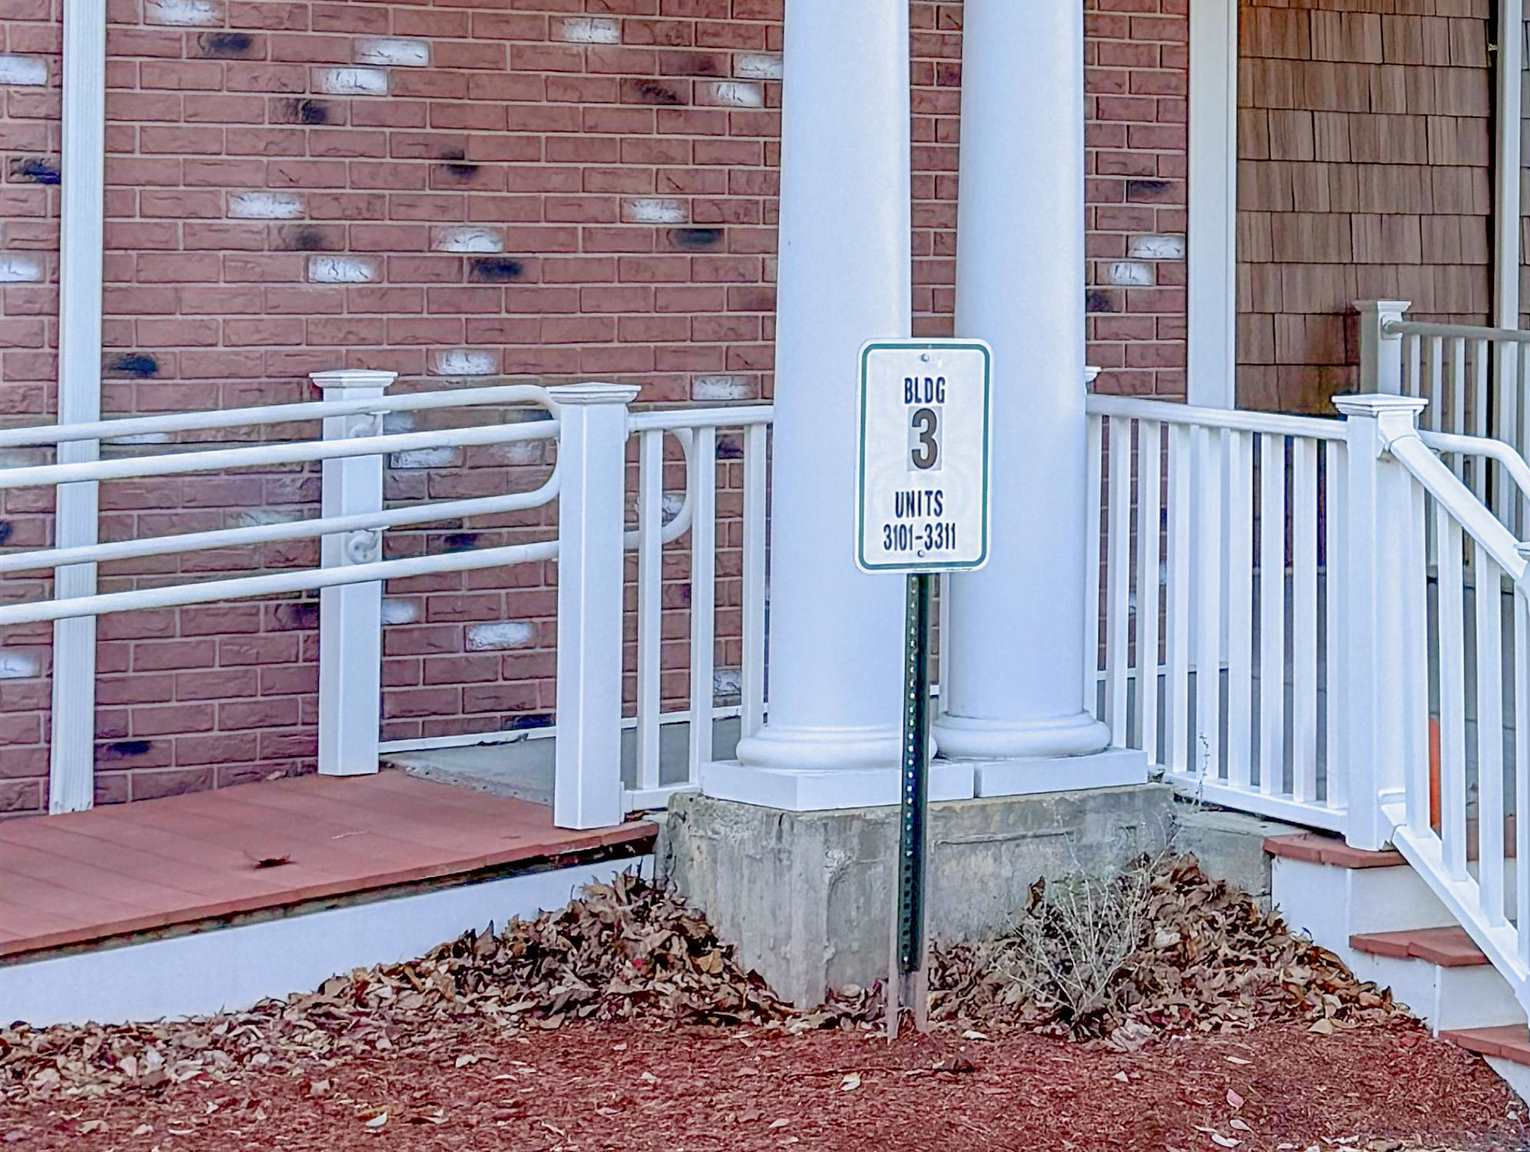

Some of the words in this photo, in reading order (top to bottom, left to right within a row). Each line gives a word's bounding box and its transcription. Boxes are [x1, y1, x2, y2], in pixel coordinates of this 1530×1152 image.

[903, 377, 946, 404] BLDG
[911, 407, 938, 470] 3
[894, 489, 944, 519] UNITS
[882, 522, 957, 552] 3101-3311
